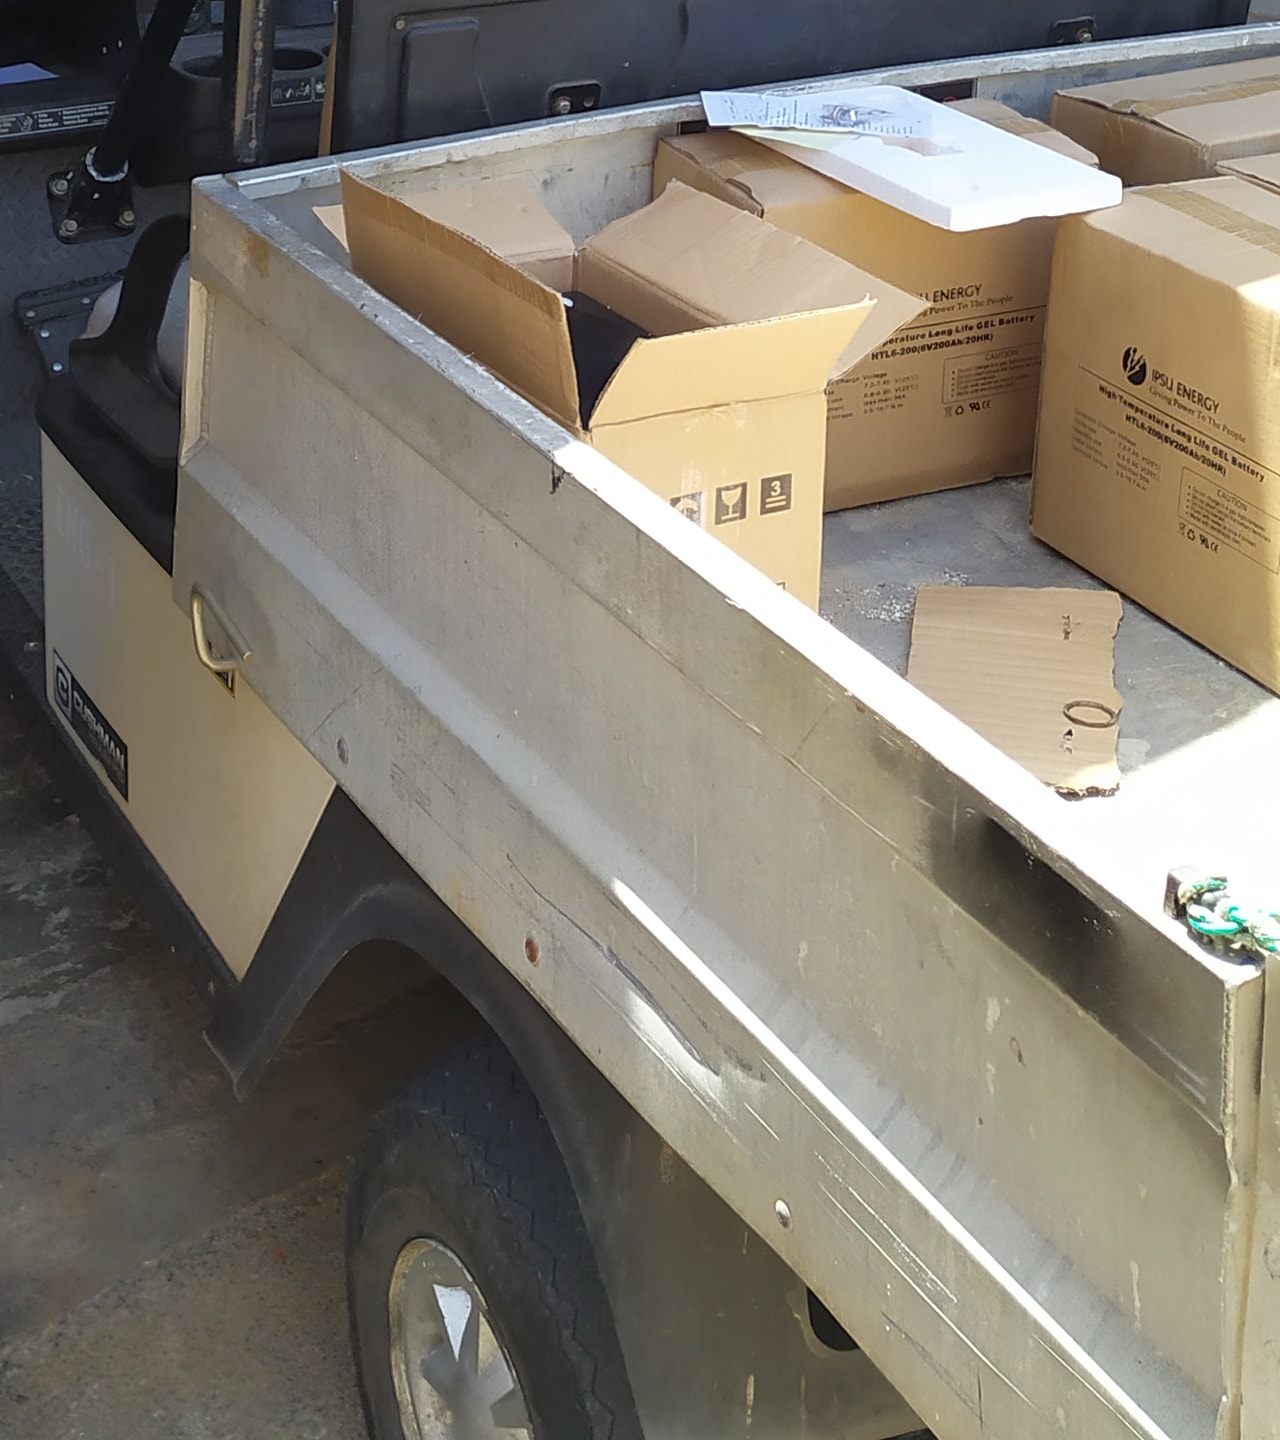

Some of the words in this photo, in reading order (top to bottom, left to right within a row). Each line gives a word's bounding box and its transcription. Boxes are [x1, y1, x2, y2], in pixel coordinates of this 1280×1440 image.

[929, 305, 955, 316] Power
[956, 301, 968, 310] To
[970, 298, 985, 308] The
[986, 294, 1014, 306] People
[932, 283, 983, 303] ENERGY
[928, 328, 953, 340] Long
[955, 323, 975, 334] Life
[976, 319, 997, 330] GEL
[998, 314, 1036, 327] Battery
[1151, 369, 1175, 392] IPSU
[1176, 381, 1220, 415] ENERGY
[1149, 386, 1173, 406] Giving
[1173, 398, 1196, 417] Power
[1197, 410, 1207, 422] To
[1208, 416, 1222, 430] The
[1222, 424, 1247, 443] People
[1098, 383, 1118, 401] High
[1118, 394, 1170, 430] Temperature
[1171, 423, 1192, 444] Long
[1193, 435, 1210, 452] Life
[1211, 445, 1230, 463] GEL
[1230, 458, 1265, 483] Battery
[770, 479, 782, 496] 3
[1216, 489, 1248, 512] CAUTION
